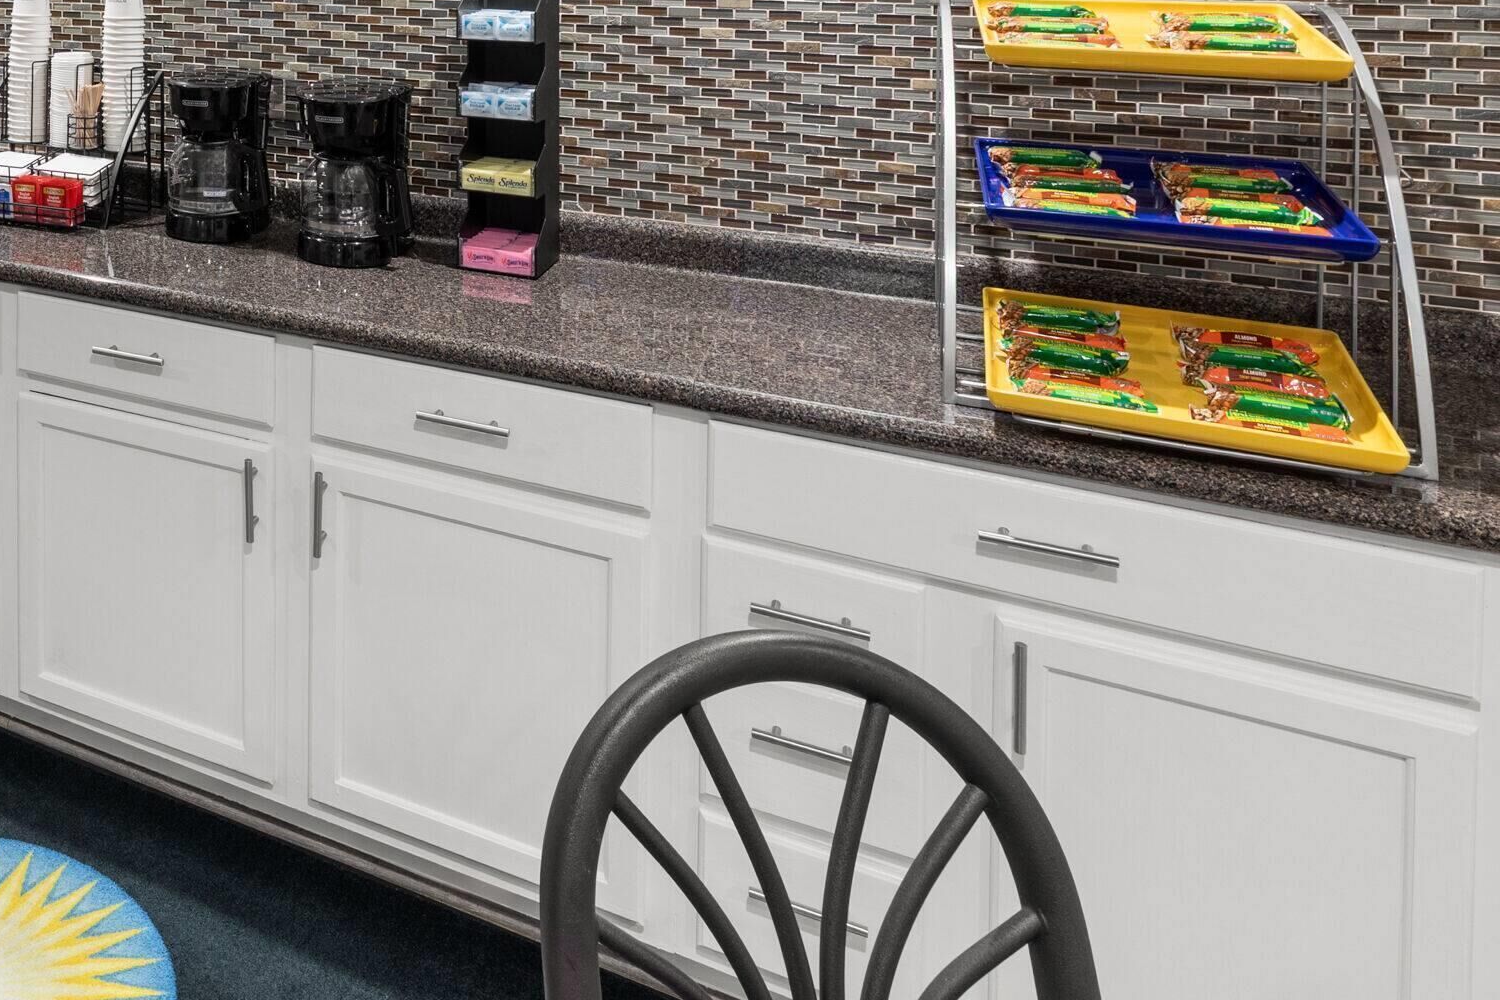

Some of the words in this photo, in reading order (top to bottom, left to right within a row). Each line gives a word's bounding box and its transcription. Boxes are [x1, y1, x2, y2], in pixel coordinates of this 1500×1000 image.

[499, 177, 528, 187] Splenda
[1234, 333, 1258, 342] ALMOND
[1243, 368, 1267, 378] ALMOND
